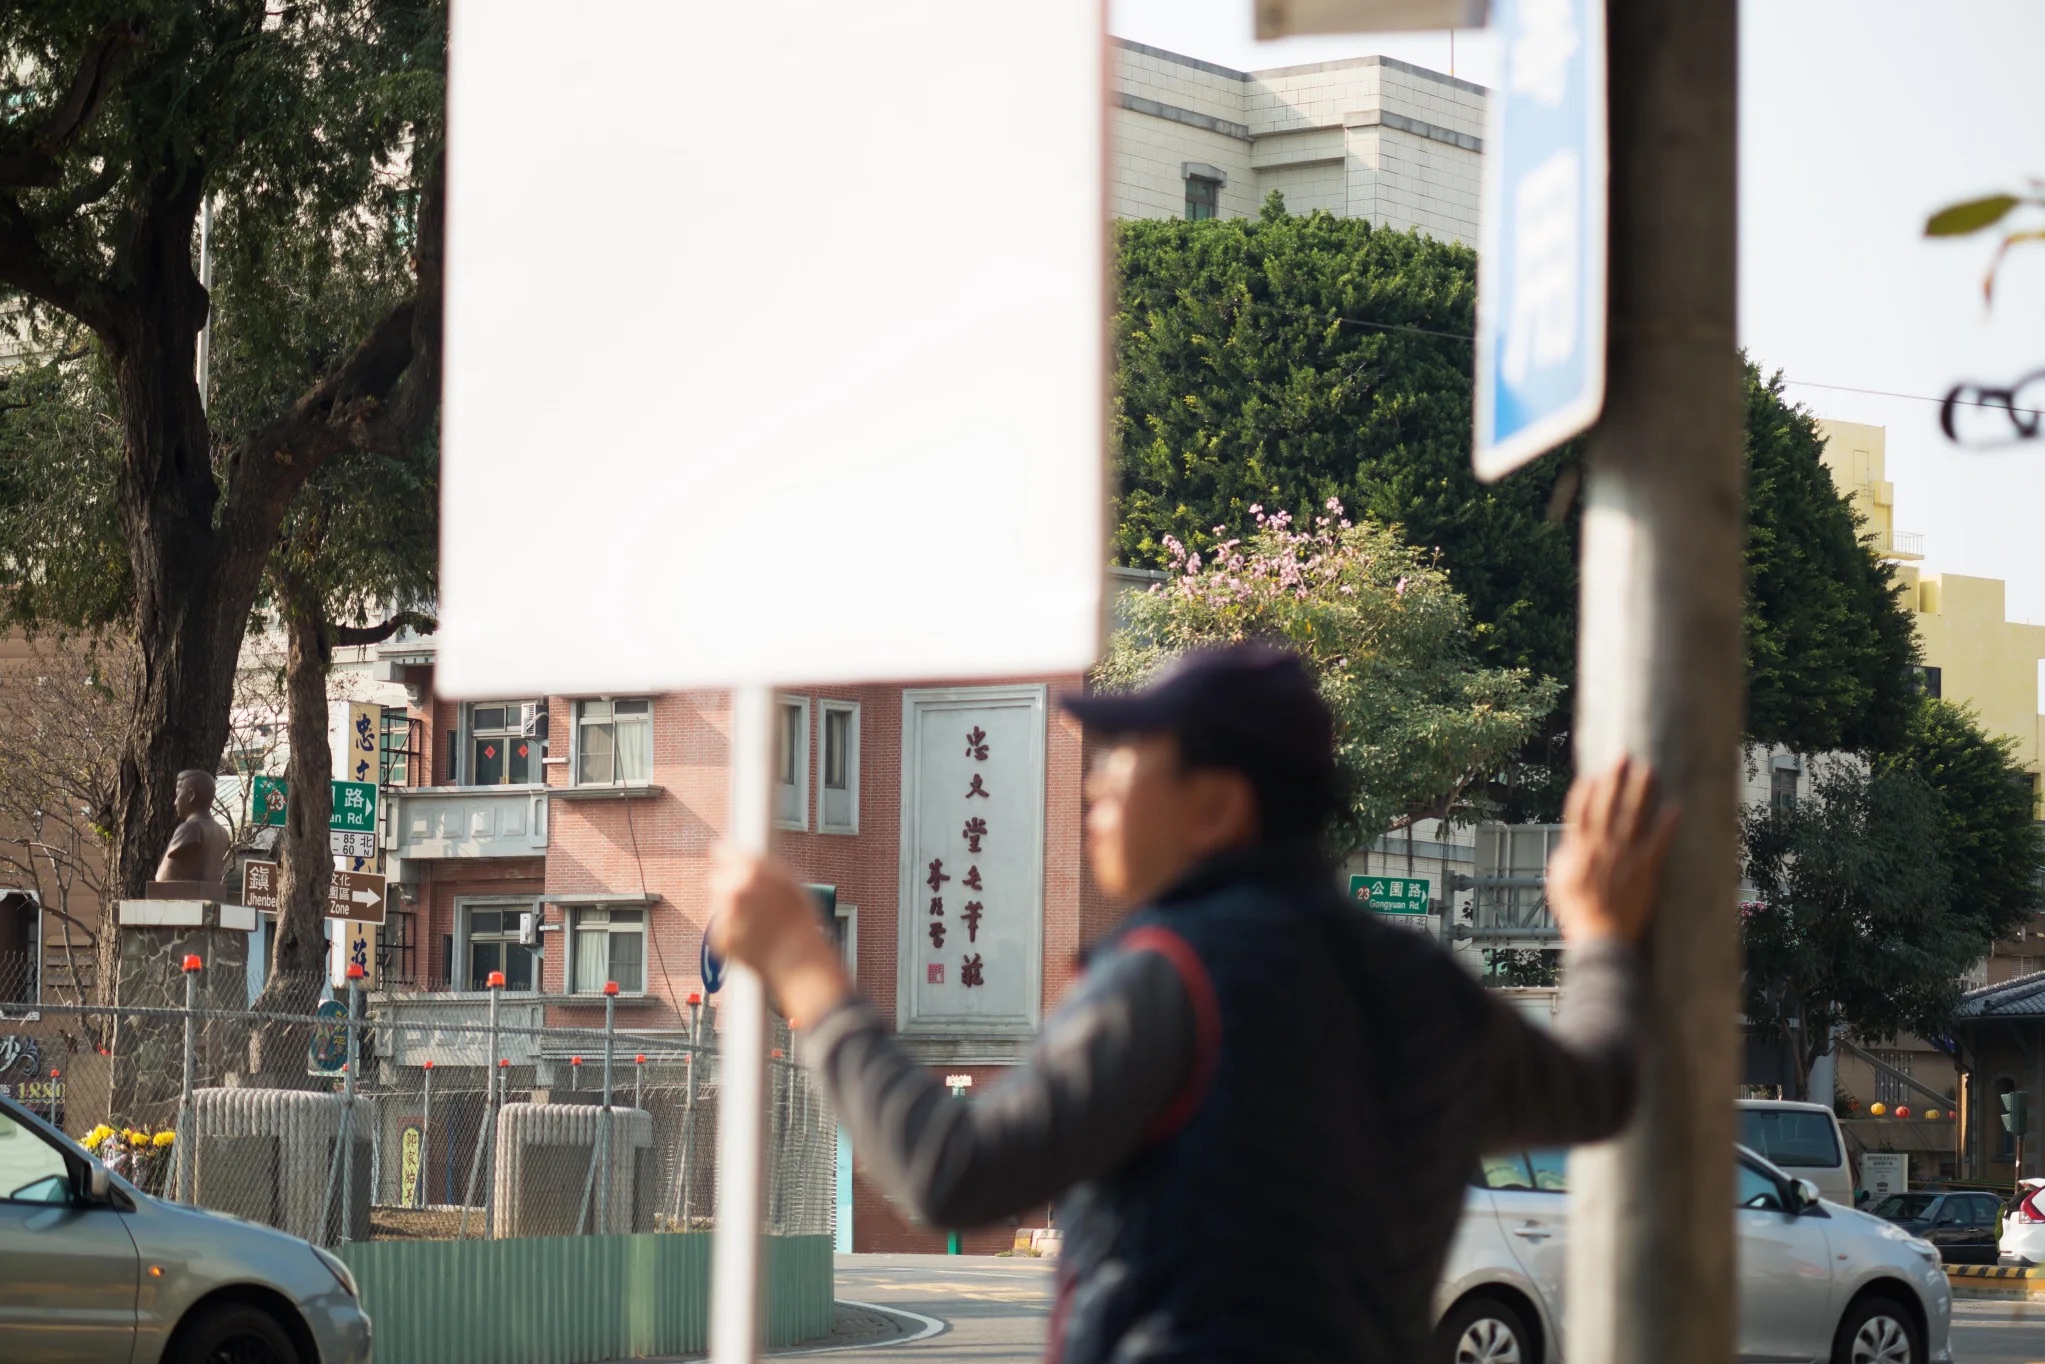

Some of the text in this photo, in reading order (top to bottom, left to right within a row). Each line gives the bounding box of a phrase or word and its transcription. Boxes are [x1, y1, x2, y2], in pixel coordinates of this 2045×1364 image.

[347, 812, 365, 826] Rd.
[343, 833, 356, 845] 85
[360, 835, 373, 848] 北
[342, 844, 355, 856] 60
[1357, 887, 1370, 900] 23
[1371, 880, 1422, 898] 公園路
[330, 900, 350, 915] Zone
[1369, 898, 1421, 911] Gongyuan Rd.
